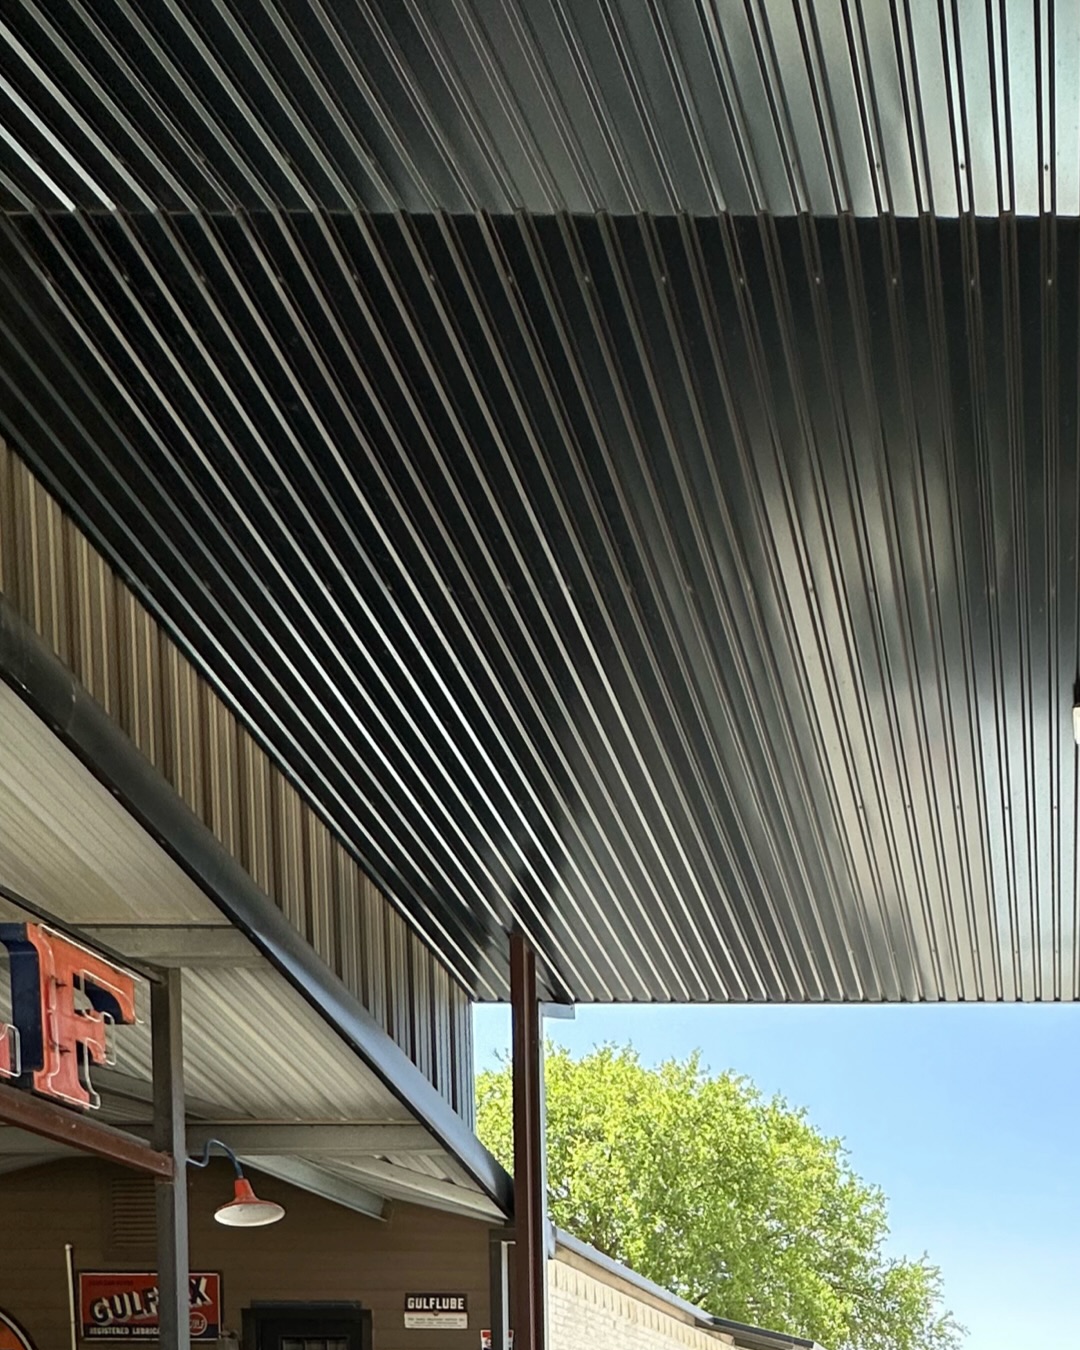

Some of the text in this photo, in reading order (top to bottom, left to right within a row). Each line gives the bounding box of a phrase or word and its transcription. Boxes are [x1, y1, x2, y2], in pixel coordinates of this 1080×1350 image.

[0, 922, 137, 1110] F
[407, 1297, 464, 1310] GULFLUBE
[132, 1327, 160, 1335] LUBRIC
